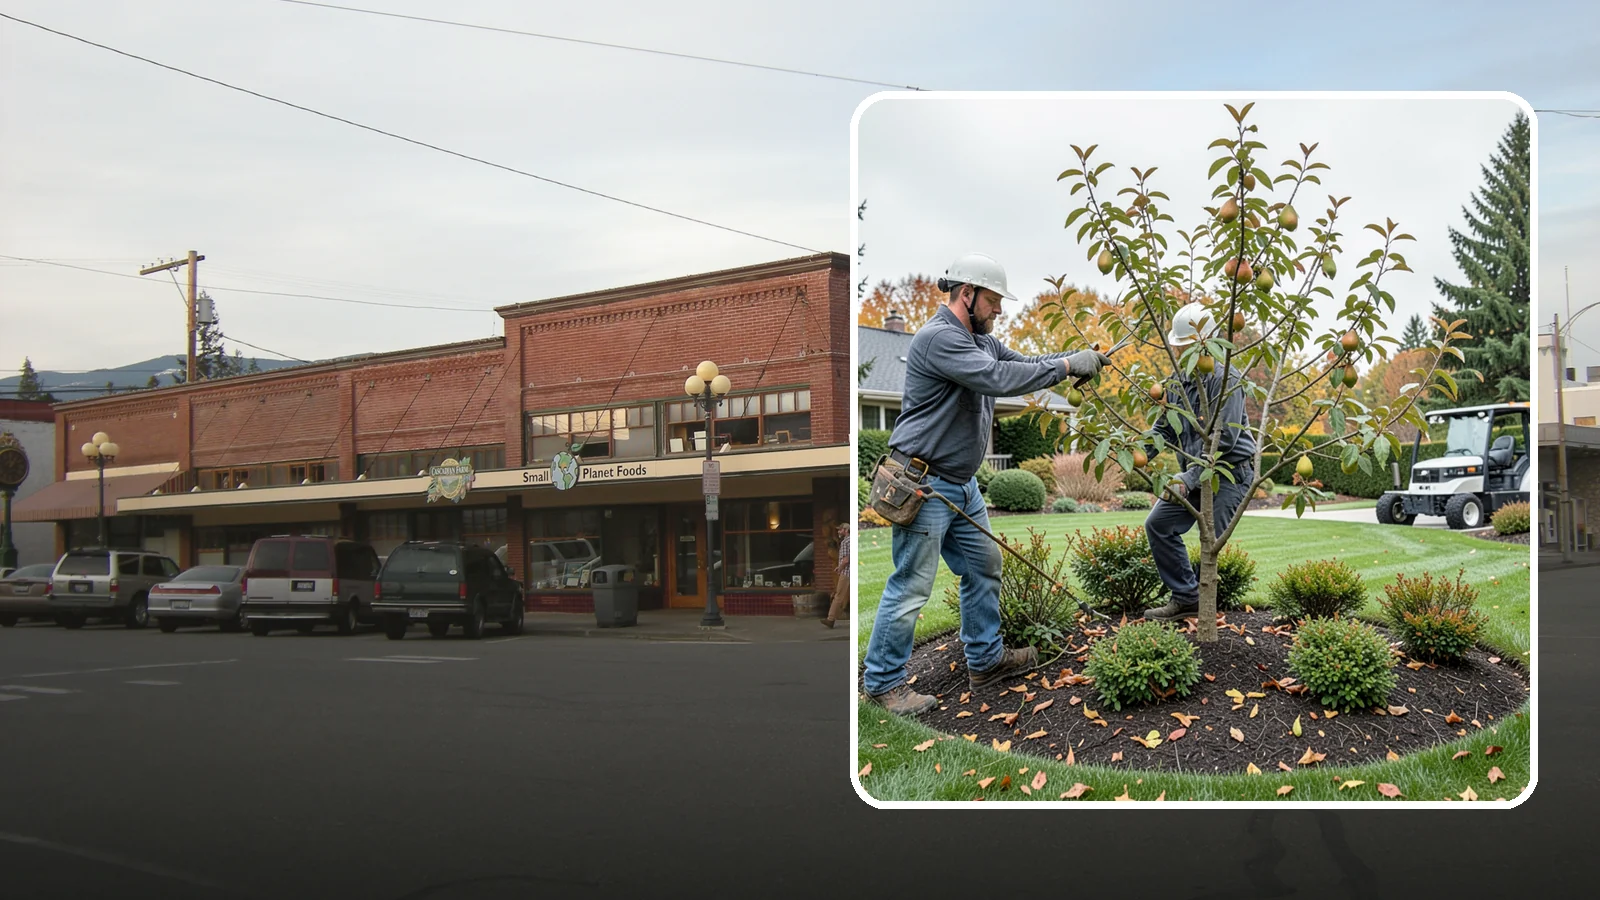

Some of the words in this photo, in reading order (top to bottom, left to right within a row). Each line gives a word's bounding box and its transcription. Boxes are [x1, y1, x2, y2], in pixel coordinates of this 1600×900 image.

[523, 471, 549, 483] Small
[583, 467, 614, 479] Planet
[616, 464, 647, 477] Foods
